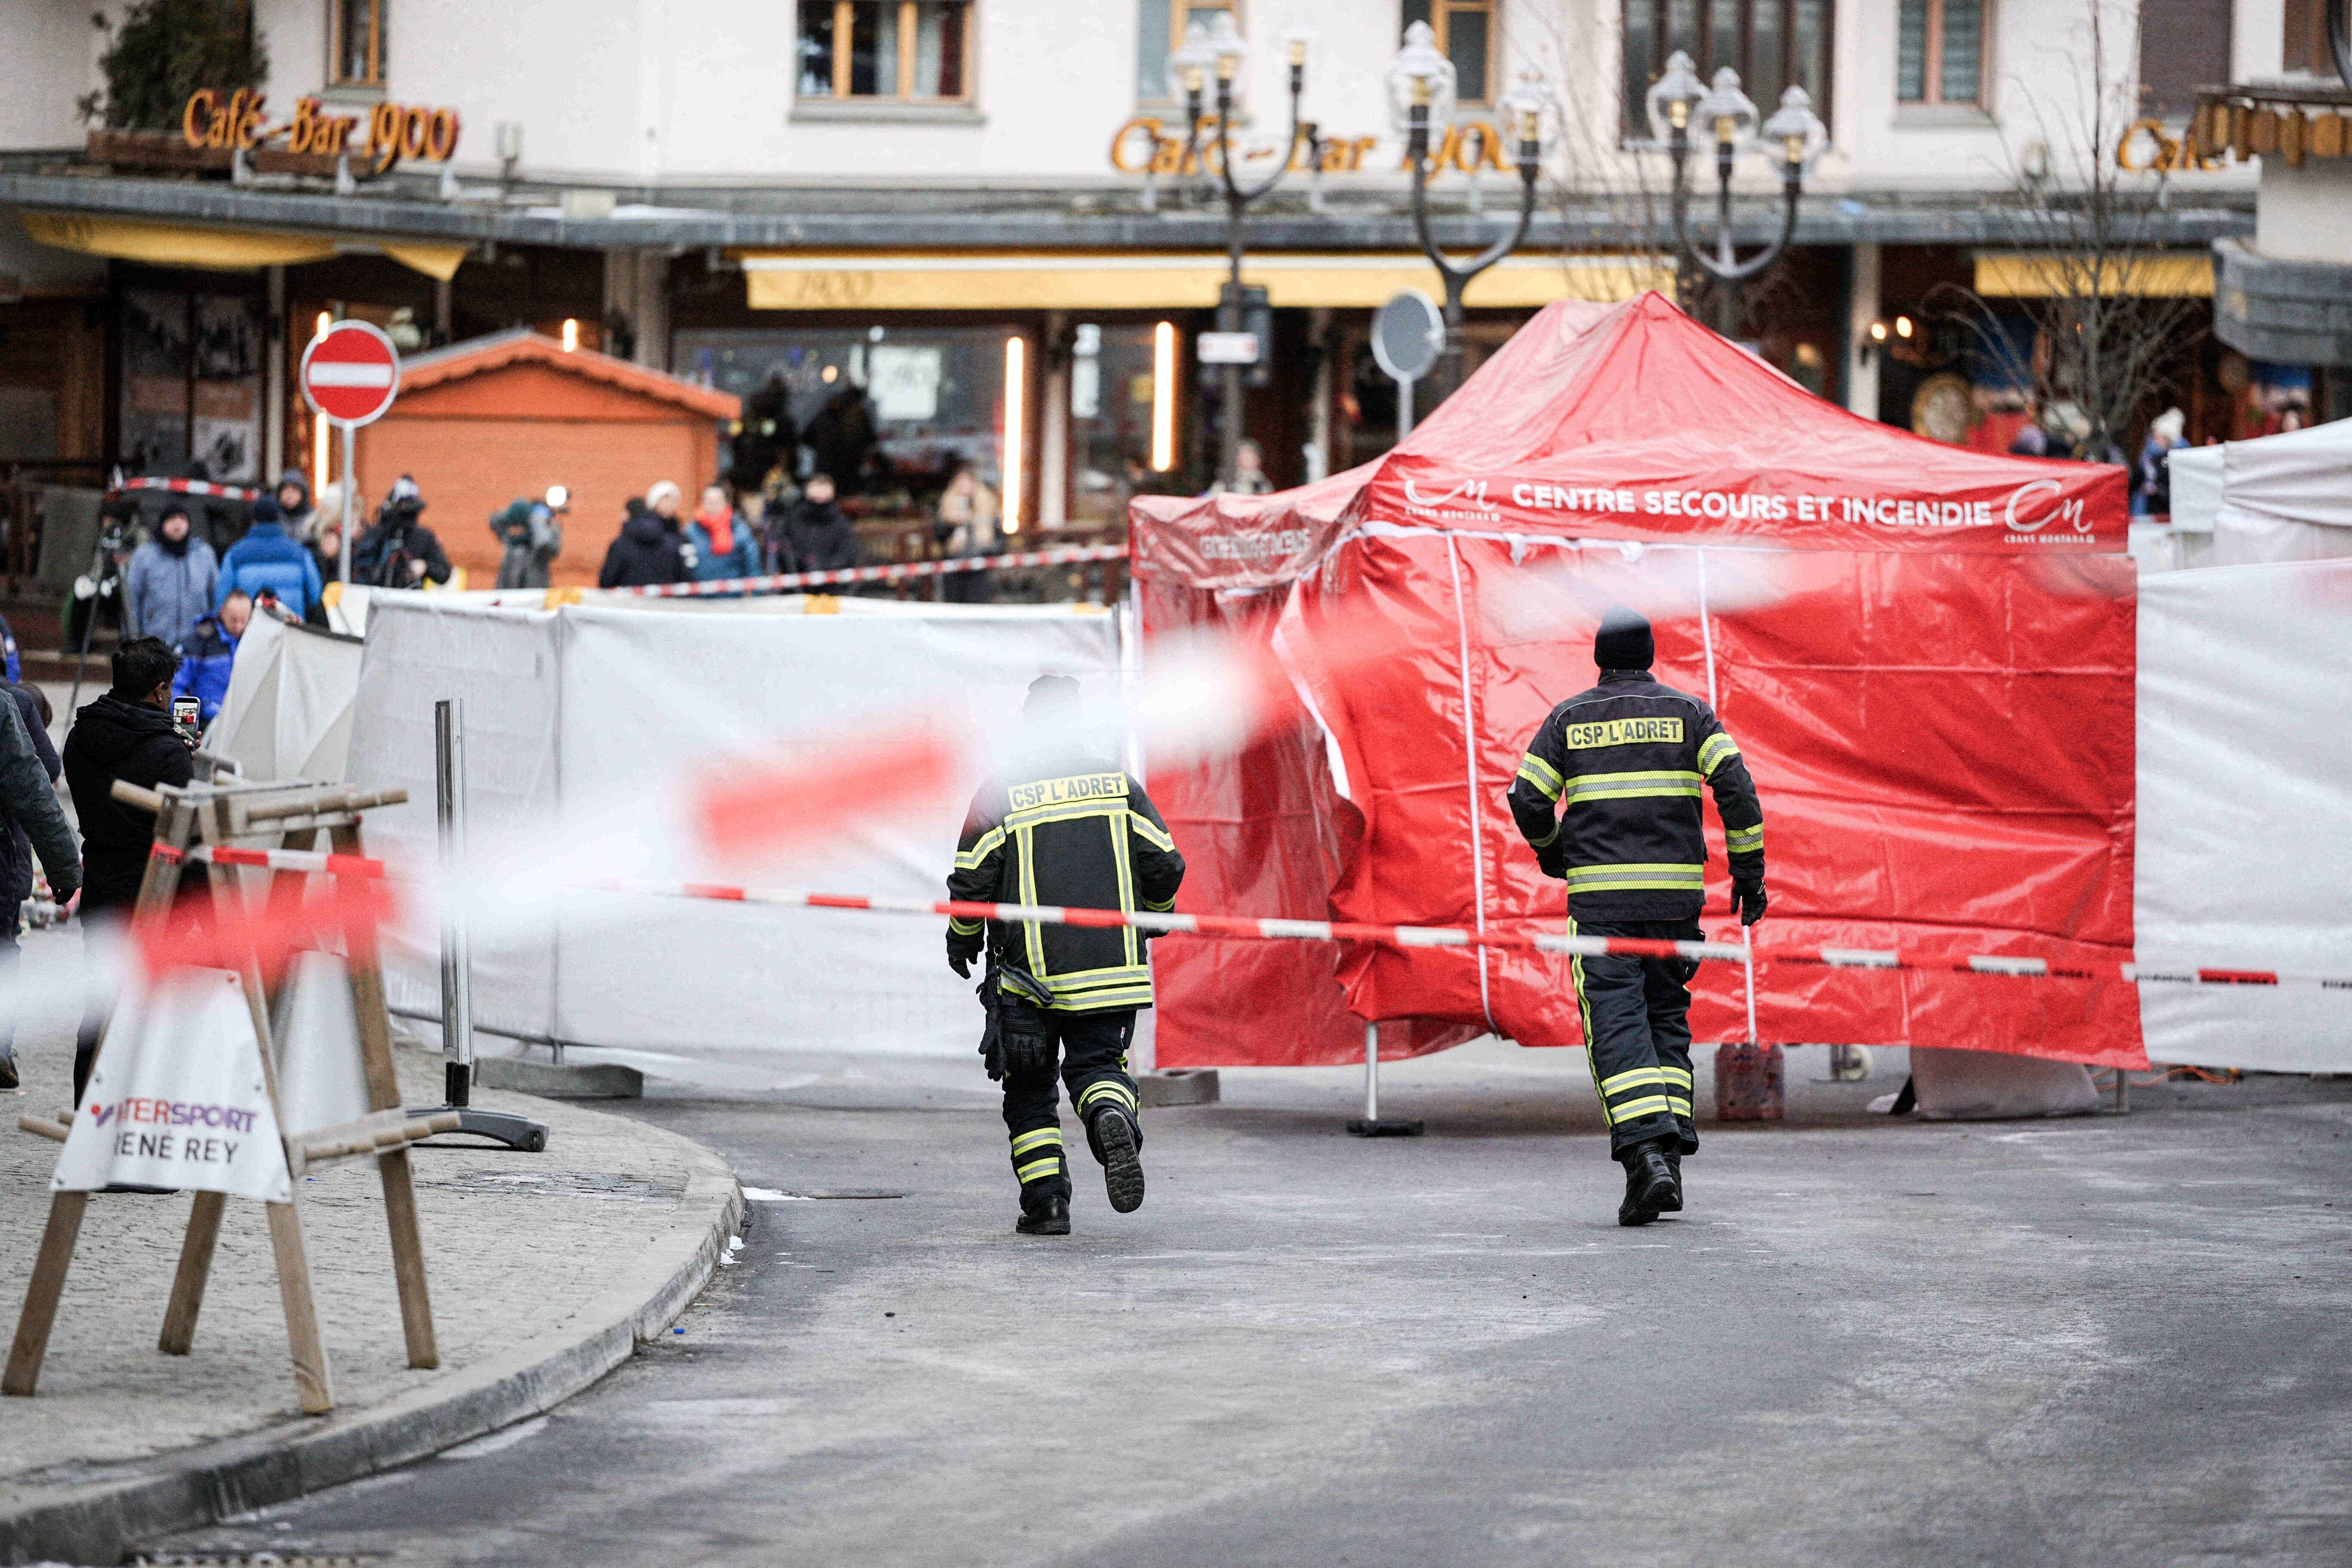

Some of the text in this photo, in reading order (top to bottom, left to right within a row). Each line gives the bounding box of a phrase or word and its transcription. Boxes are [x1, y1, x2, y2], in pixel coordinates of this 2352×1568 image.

[363, 101, 460, 174] 1900
[1512, 483, 1993, 527] CENTRE SECOURS ET INCENDIE
[1571, 725, 1604, 746] CSP
[1012, 783, 1046, 808] CSP
[185, 1137, 238, 1164] REY
